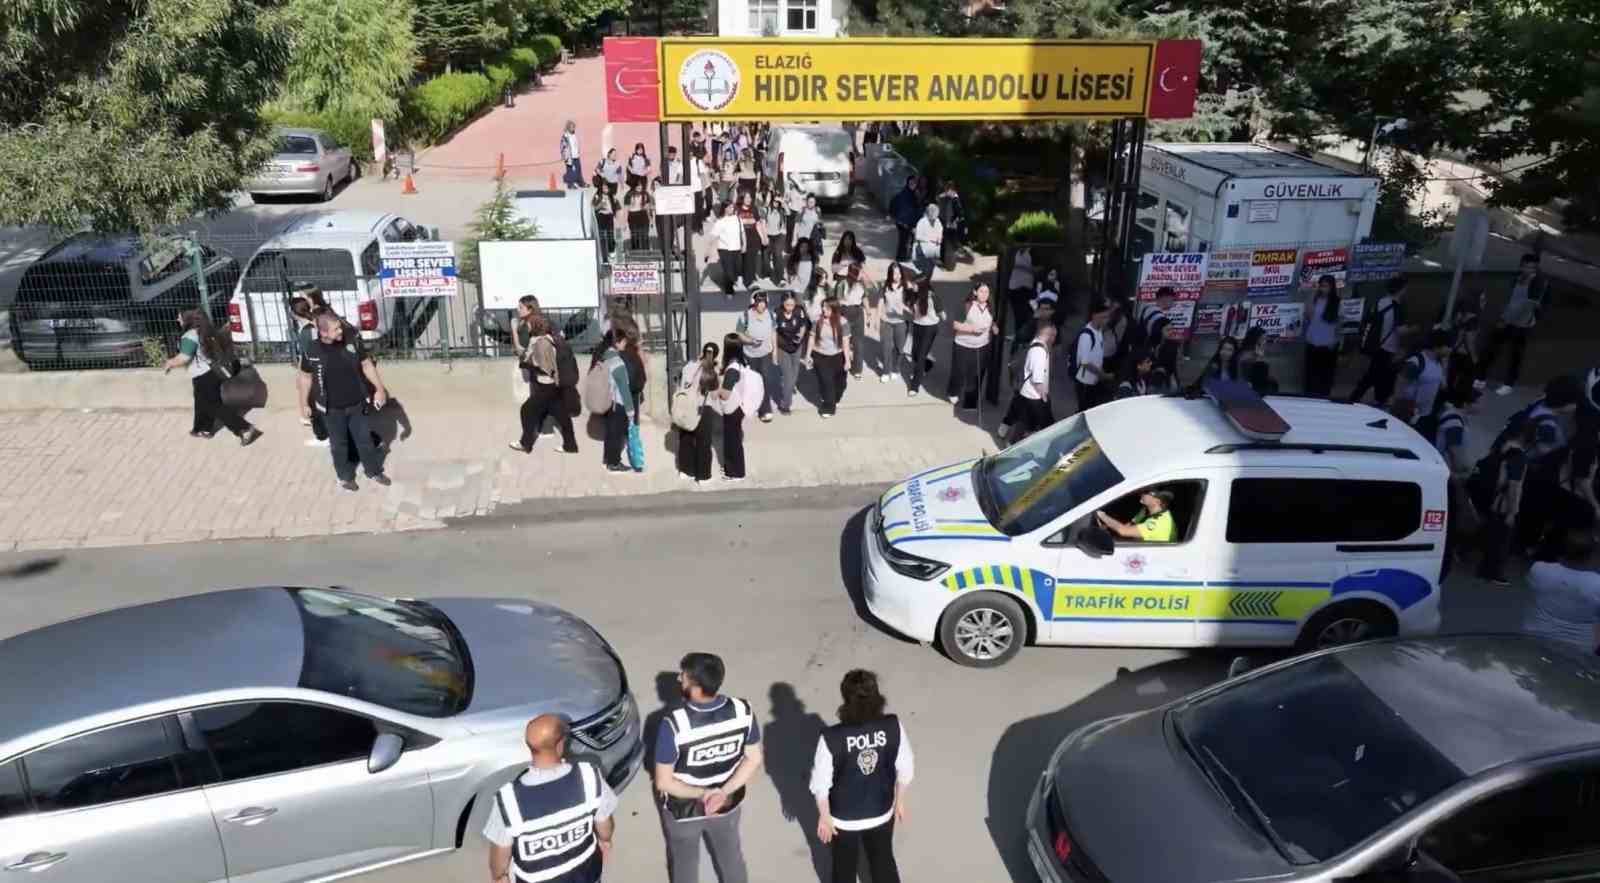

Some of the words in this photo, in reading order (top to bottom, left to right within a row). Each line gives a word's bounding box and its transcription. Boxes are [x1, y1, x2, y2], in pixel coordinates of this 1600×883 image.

[755, 52, 812, 69] ELAZIĞ
[755, 74, 827, 101] HIDIR
[836, 74, 919, 101] SEVER
[927, 73, 1048, 101] ANADOLU
[1056, 67, 1135, 100] LİSESİ
[383, 258, 416, 269] HIDIR
[417, 258, 453, 268] SEVER
[1151, 254, 1179, 264] KLAS
[1181, 254, 1203, 264] TUR
[1253, 252, 1295, 264] OMRAK
[1256, 318, 1281, 328] OKUL
[1427, 512, 1442, 523] 112
[1064, 593, 1127, 608] TRAFİK
[1132, 594, 1190, 610] POLİSİ
[846, 730, 887, 752] POLIS
[696, 742, 737, 761] POLIS
[528, 822, 587, 855] POLIS
